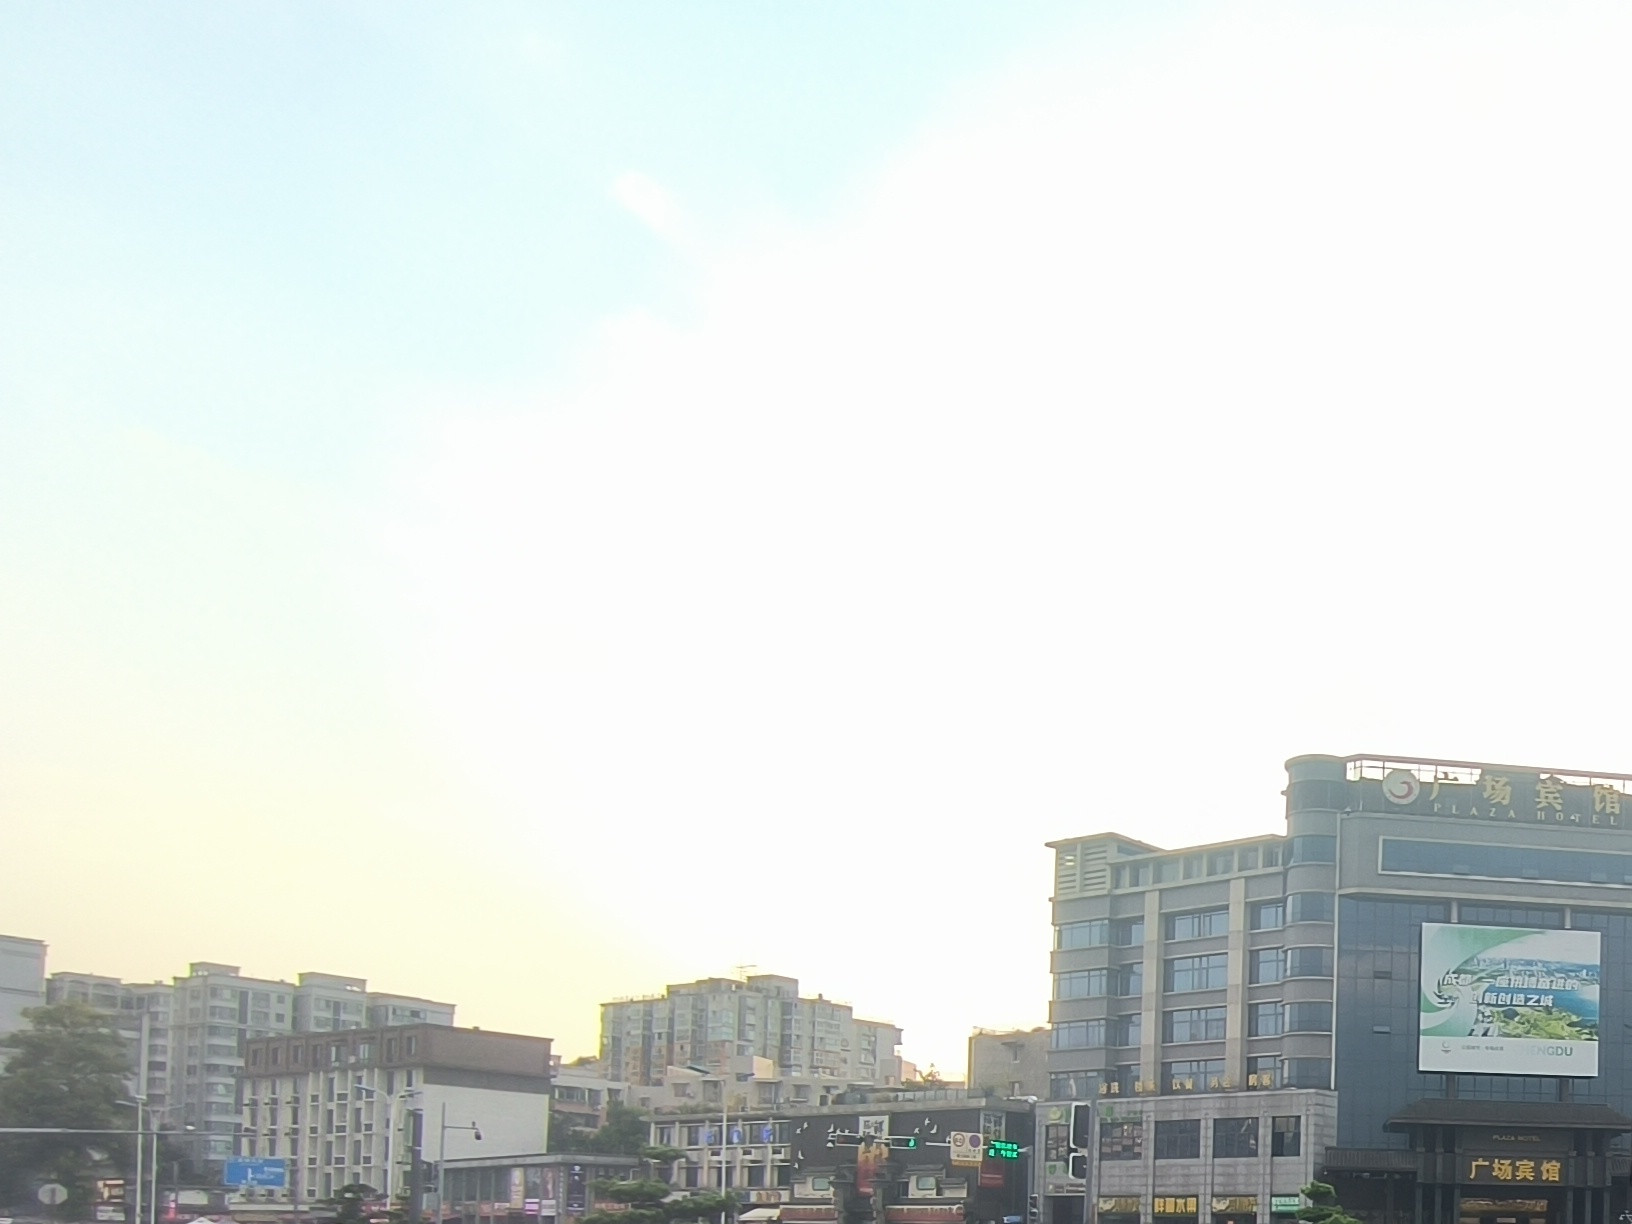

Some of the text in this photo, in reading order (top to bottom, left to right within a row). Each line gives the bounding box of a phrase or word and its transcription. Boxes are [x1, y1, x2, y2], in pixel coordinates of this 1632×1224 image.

[1429, 770, 1621, 815] 广场宾馆
[1433, 803, 1618, 826] PLAZA HOTEL
[1469, 1157, 1561, 1181] 广场宾馆
